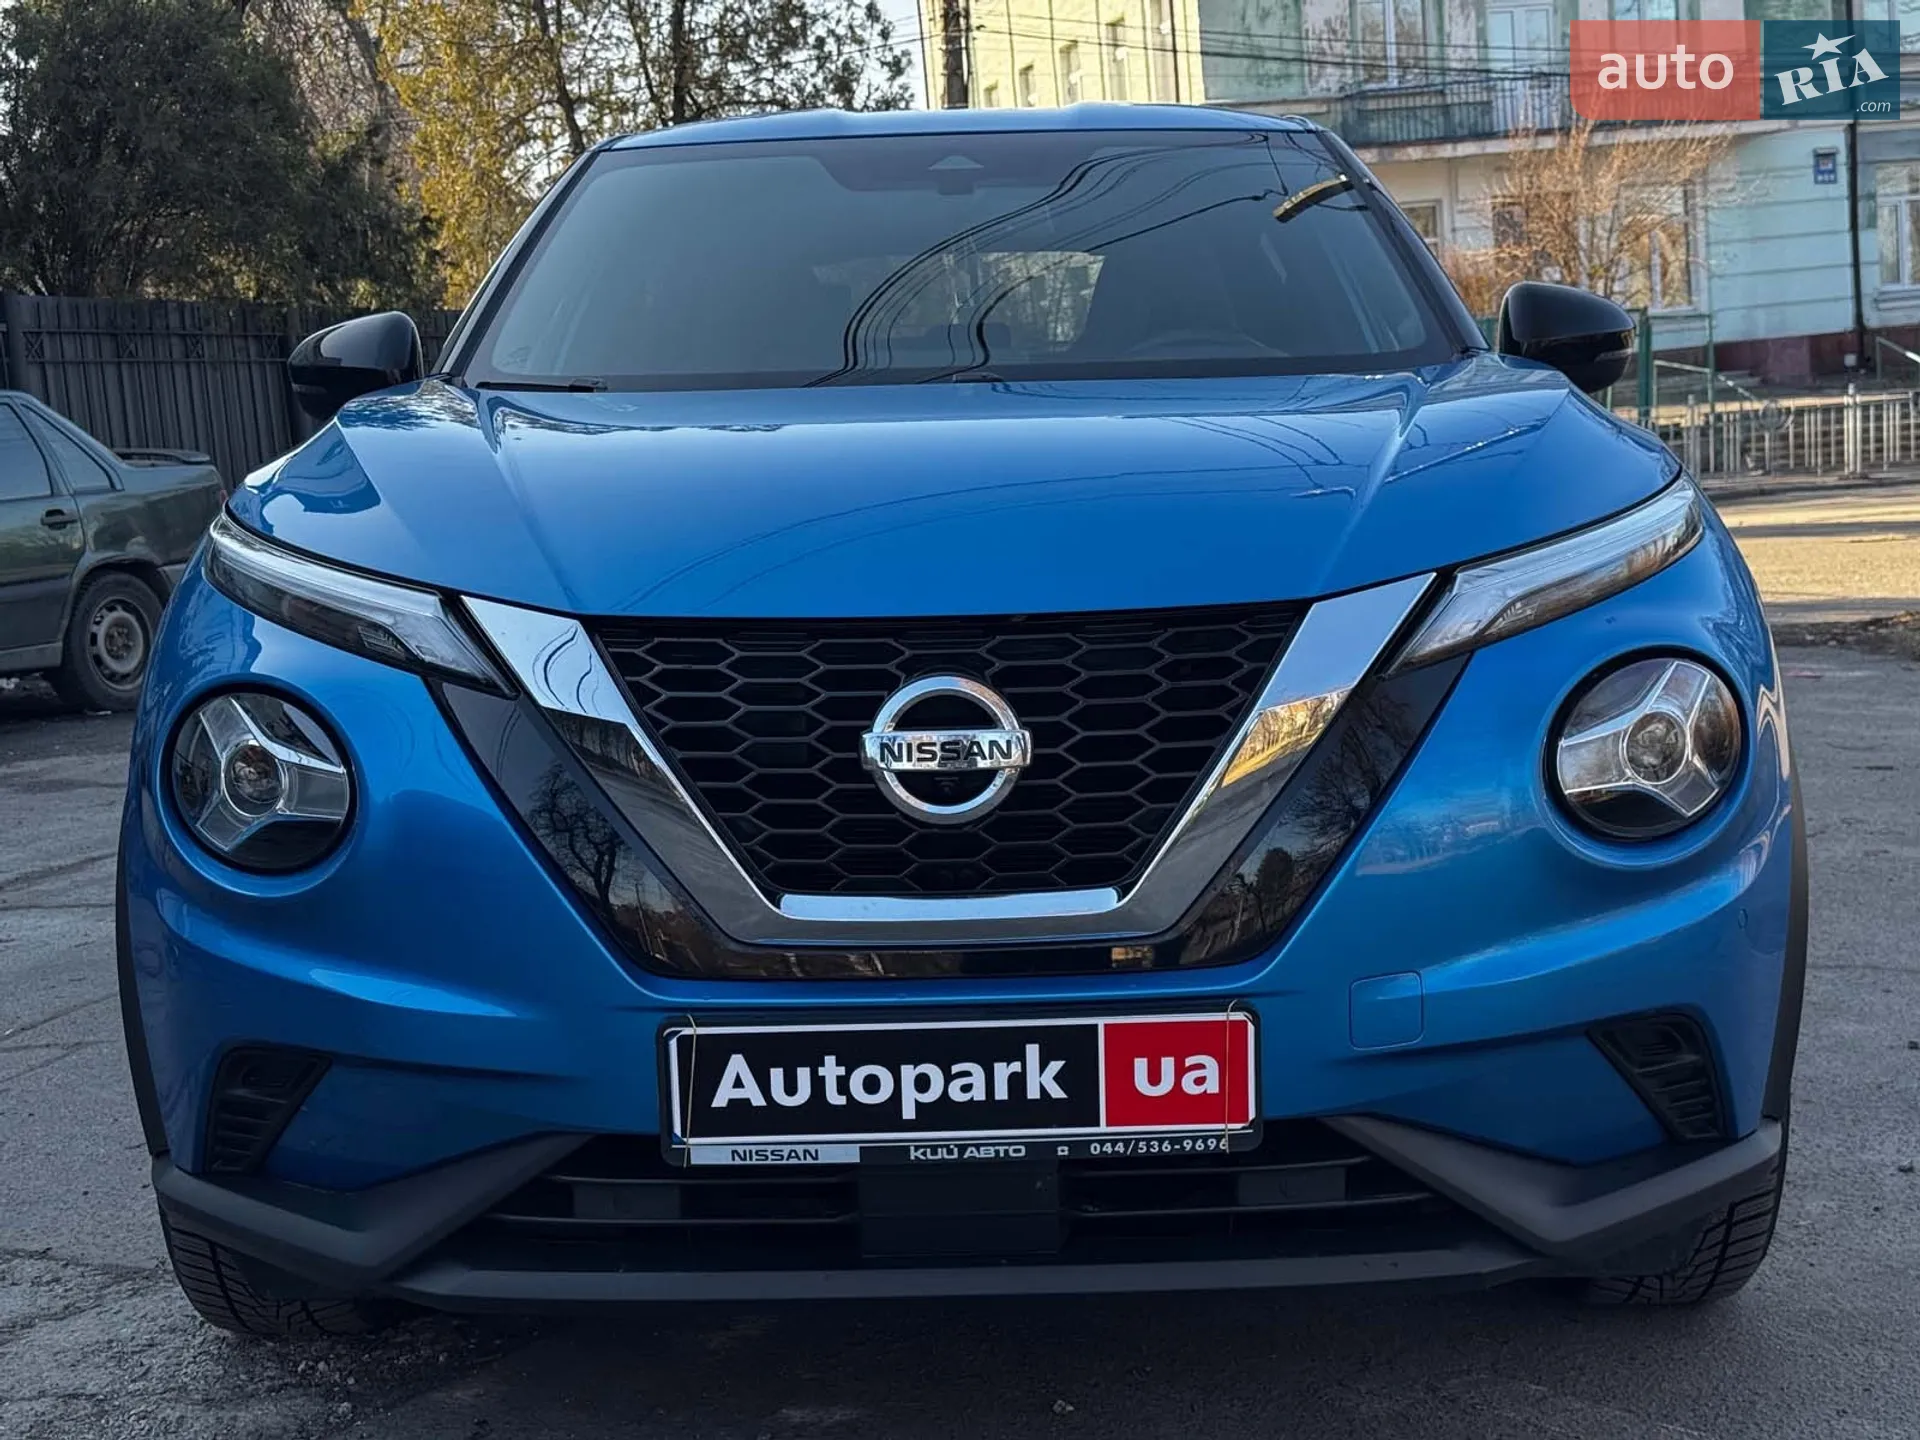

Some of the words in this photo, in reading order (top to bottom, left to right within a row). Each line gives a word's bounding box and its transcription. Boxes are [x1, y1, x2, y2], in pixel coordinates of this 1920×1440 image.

[879, 739, 1013, 764] NISSAN
[711, 1043, 1068, 1120] Autopark
[1133, 1053, 1221, 1097] ua
[730, 1148, 820, 1163] NISSAN
[963, 1145, 1026, 1159] АВТО
